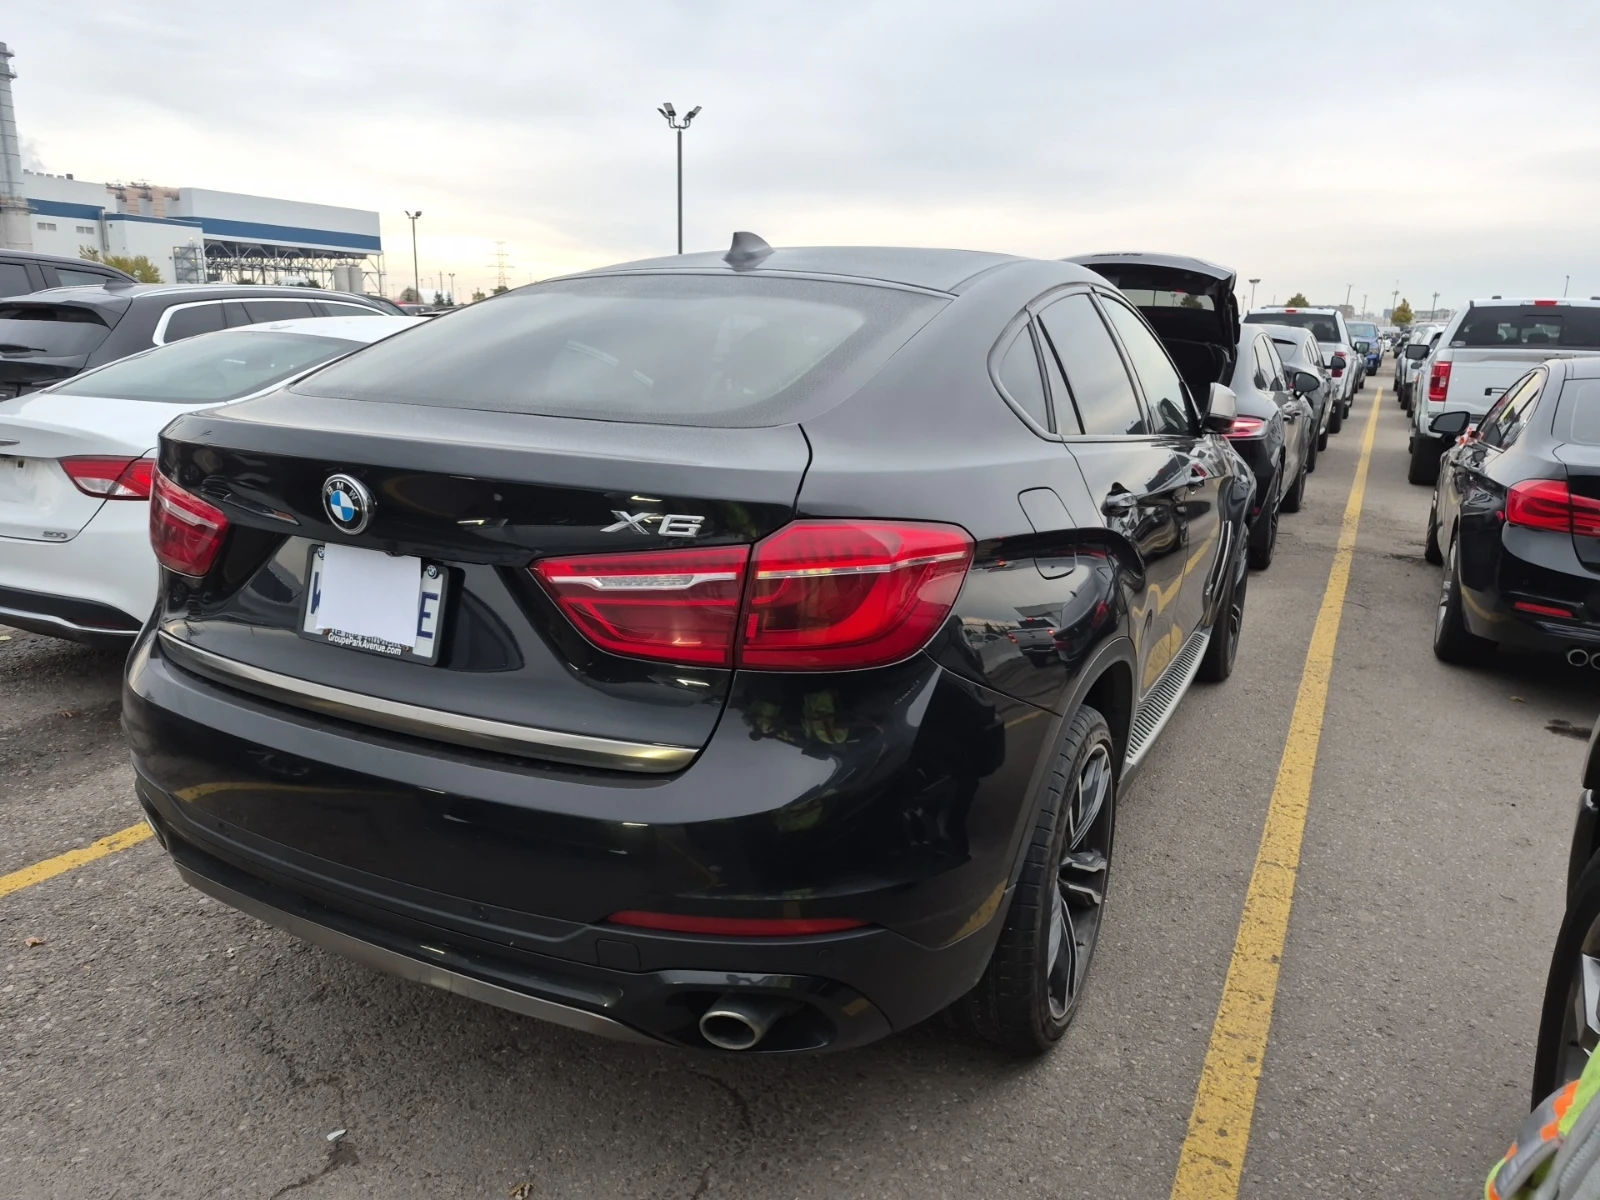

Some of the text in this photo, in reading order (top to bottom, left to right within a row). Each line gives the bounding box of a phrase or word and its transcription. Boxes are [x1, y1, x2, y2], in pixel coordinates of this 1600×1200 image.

[326, 481, 359, 500] BMW
[600, 510, 705, 537] X6
[327, 632, 402, 656] GroupeParkAvenue.com
